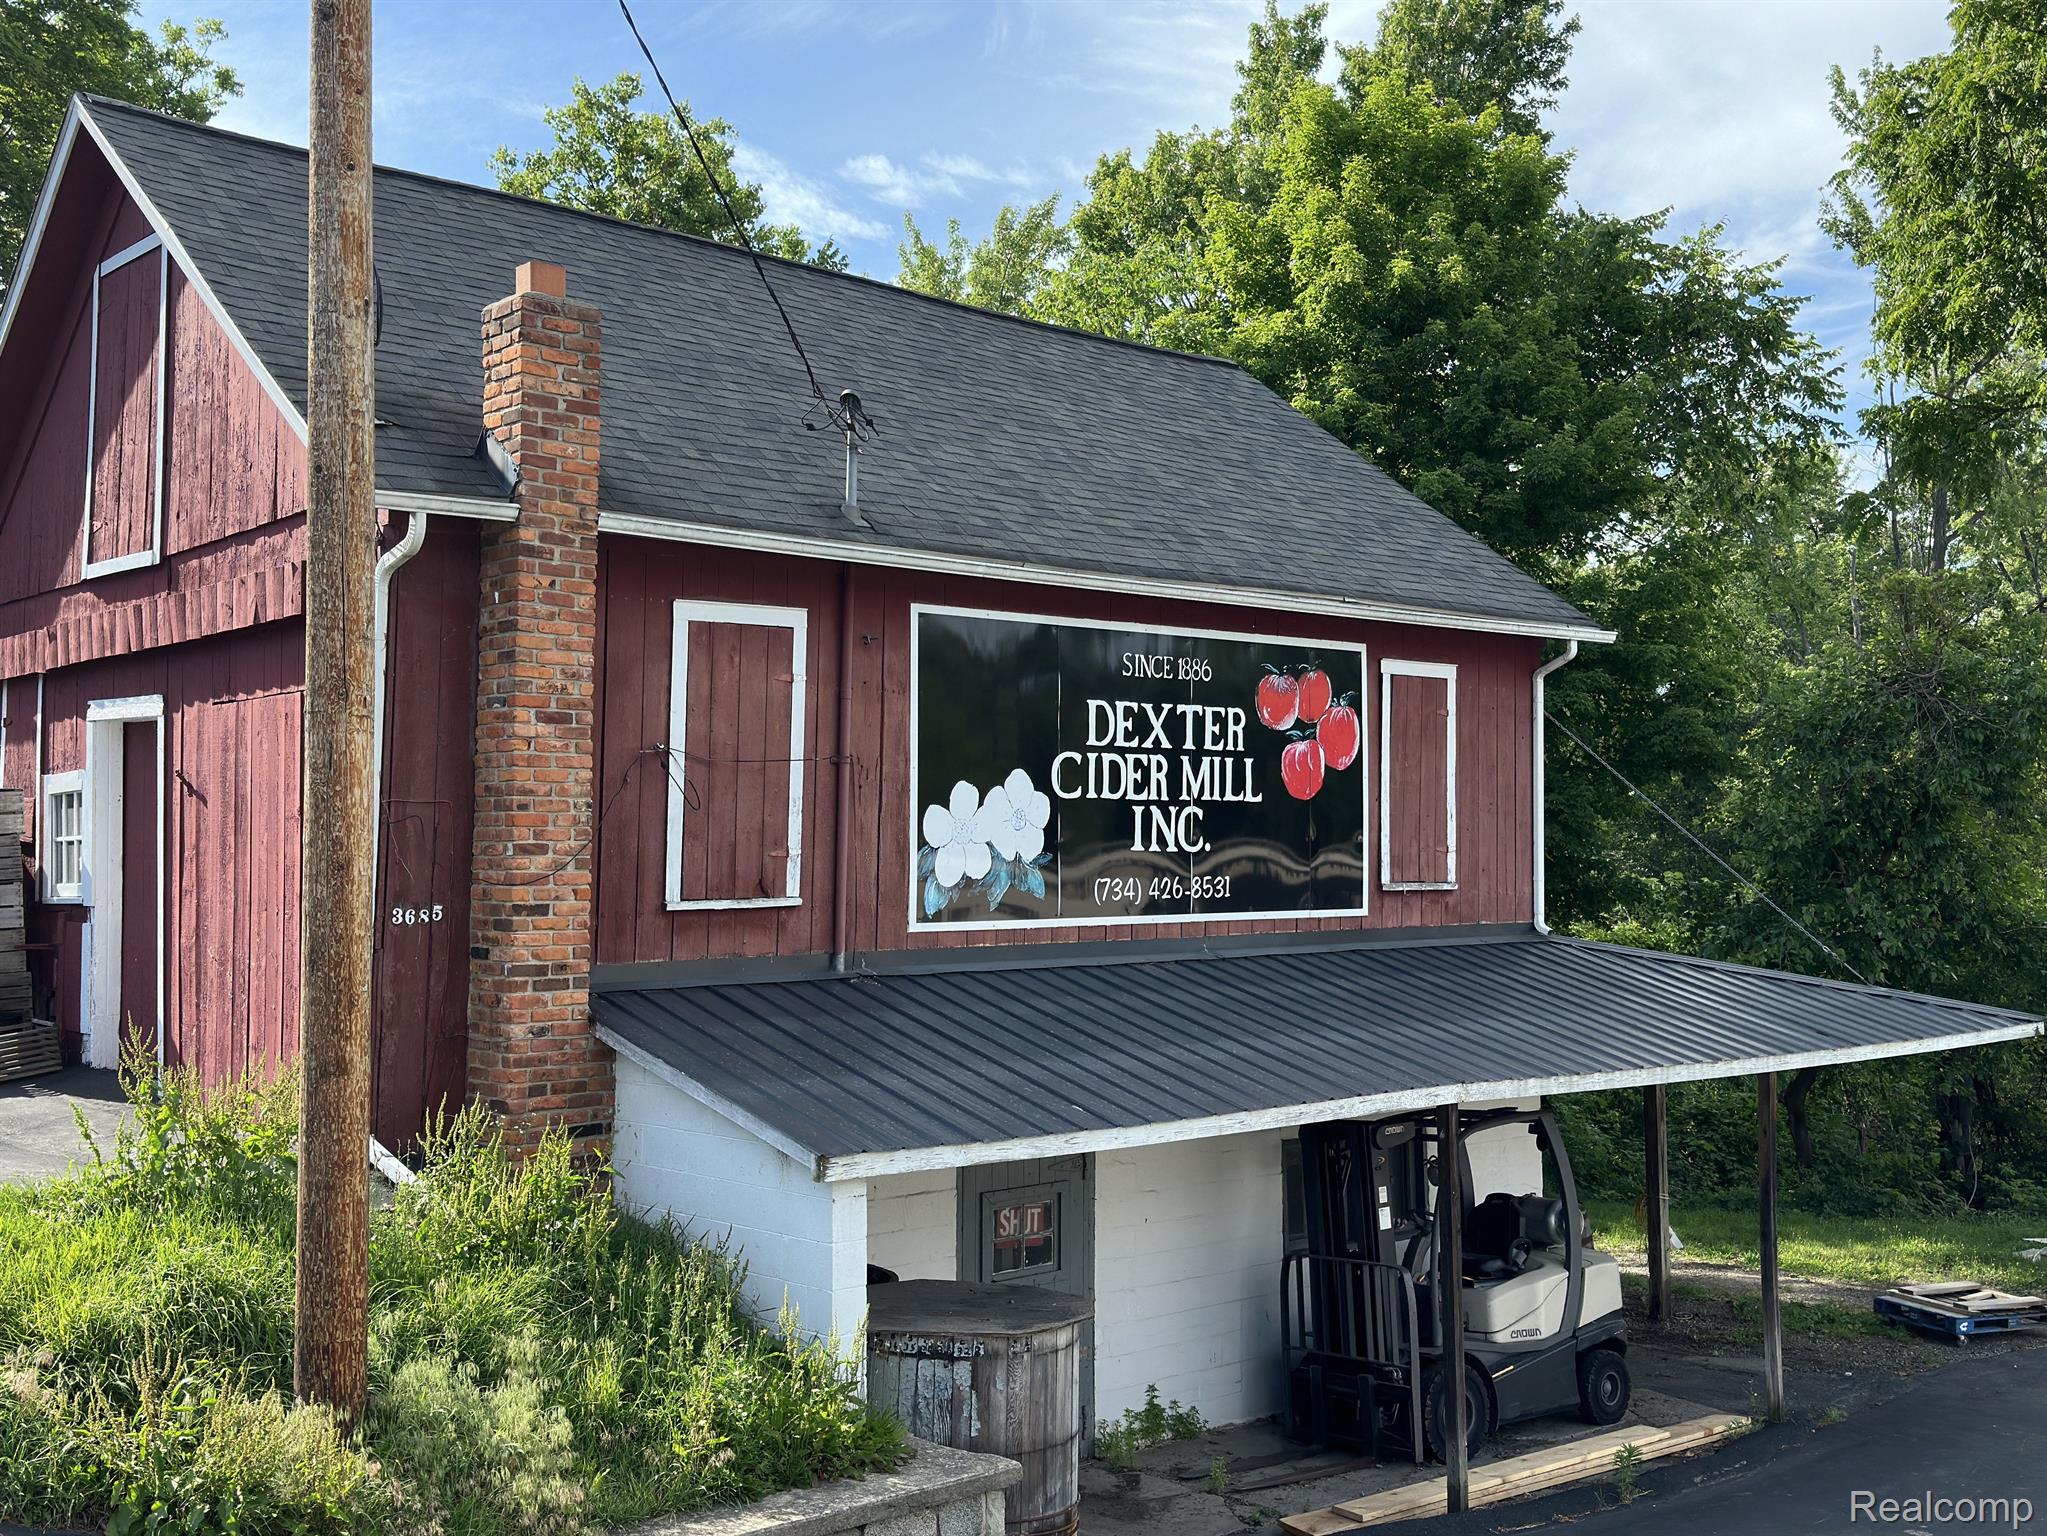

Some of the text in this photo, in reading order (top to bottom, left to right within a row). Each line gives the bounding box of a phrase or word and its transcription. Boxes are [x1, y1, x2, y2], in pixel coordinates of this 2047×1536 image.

[1122, 652, 1212, 682] SINCE 1886
[1086, 699, 1246, 751] DEXTER
[1051, 751, 1263, 802] CIDER MILL
[1130, 805, 1211, 852] INC.
[1094, 876, 1231, 906] (734) 426-8531
[391, 904, 443, 925] 3685
[1511, 1328, 1541, 1339] CROWN
